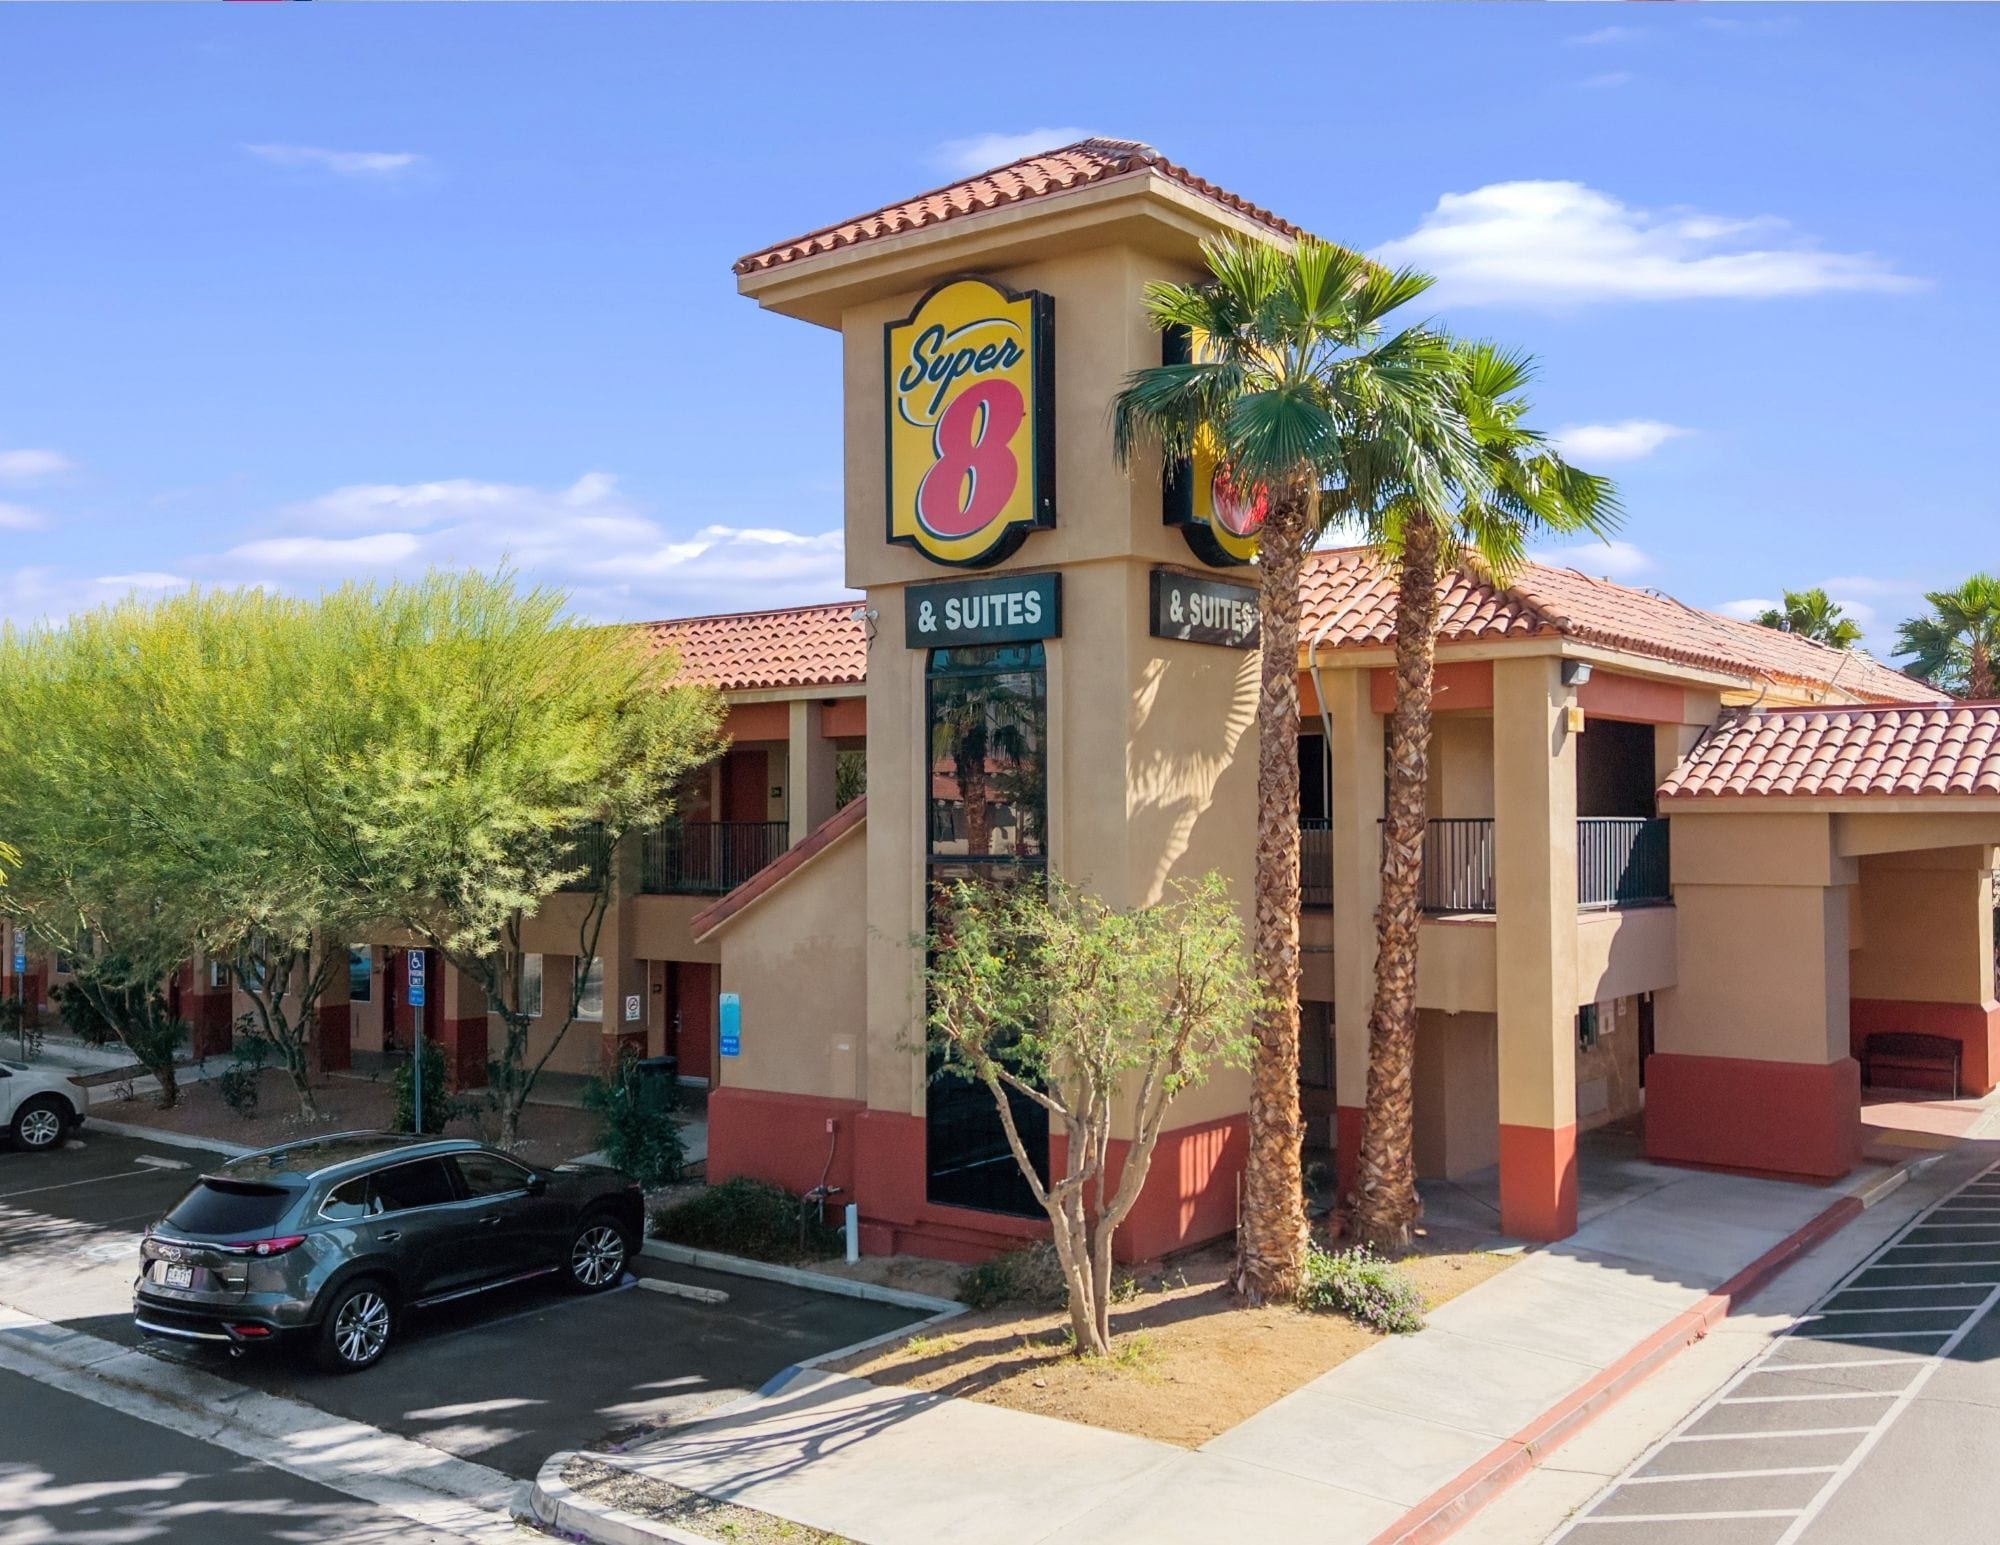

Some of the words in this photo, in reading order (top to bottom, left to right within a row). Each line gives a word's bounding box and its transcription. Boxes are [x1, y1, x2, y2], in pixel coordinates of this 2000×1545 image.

[898, 323, 1025, 416] Super
[915, 379, 1024, 539] 8
[917, 600, 937, 633] &
[945, 589, 1042, 631] SUITES
[1169, 588, 1185, 623] &
[1189, 592, 1253, 636] SUITES
